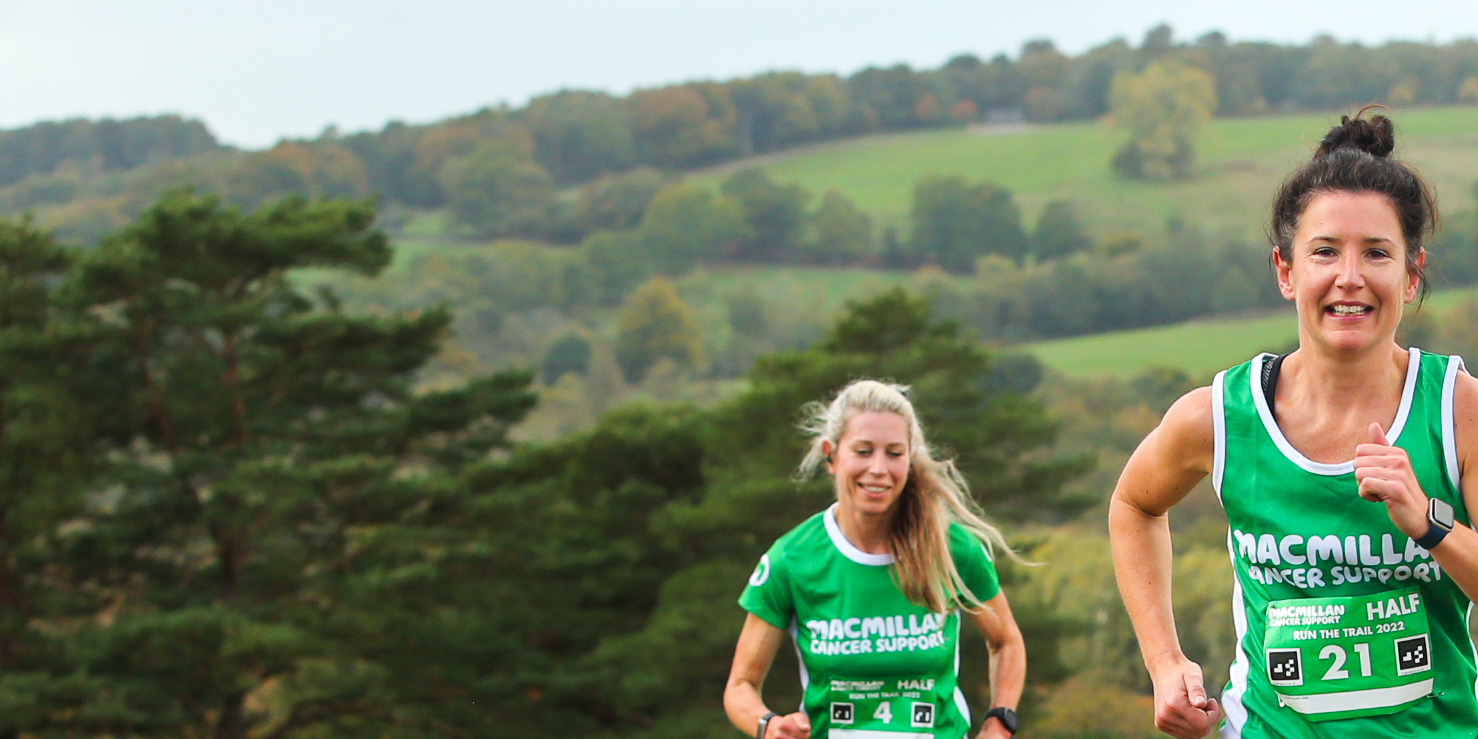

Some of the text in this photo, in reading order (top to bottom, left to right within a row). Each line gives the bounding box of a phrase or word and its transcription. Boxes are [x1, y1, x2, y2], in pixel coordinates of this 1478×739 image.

[1233, 529, 1430, 566] MACMILLA
[1248, 560, 1441, 589] ANCER SUPPORT
[1268, 604, 1345, 619] MACMILLAN
[1366, 593, 1420, 621] HALF
[1269, 615, 1341, 627] CANCER SUPPORT
[1293, 621, 1405, 641] RUN THE TRAIL 2022
[810, 638, 873, 656] CANCER
[1318, 642, 1372, 681] 21
[897, 679, 935, 691] HALF
[872, 701, 893, 724] 4
